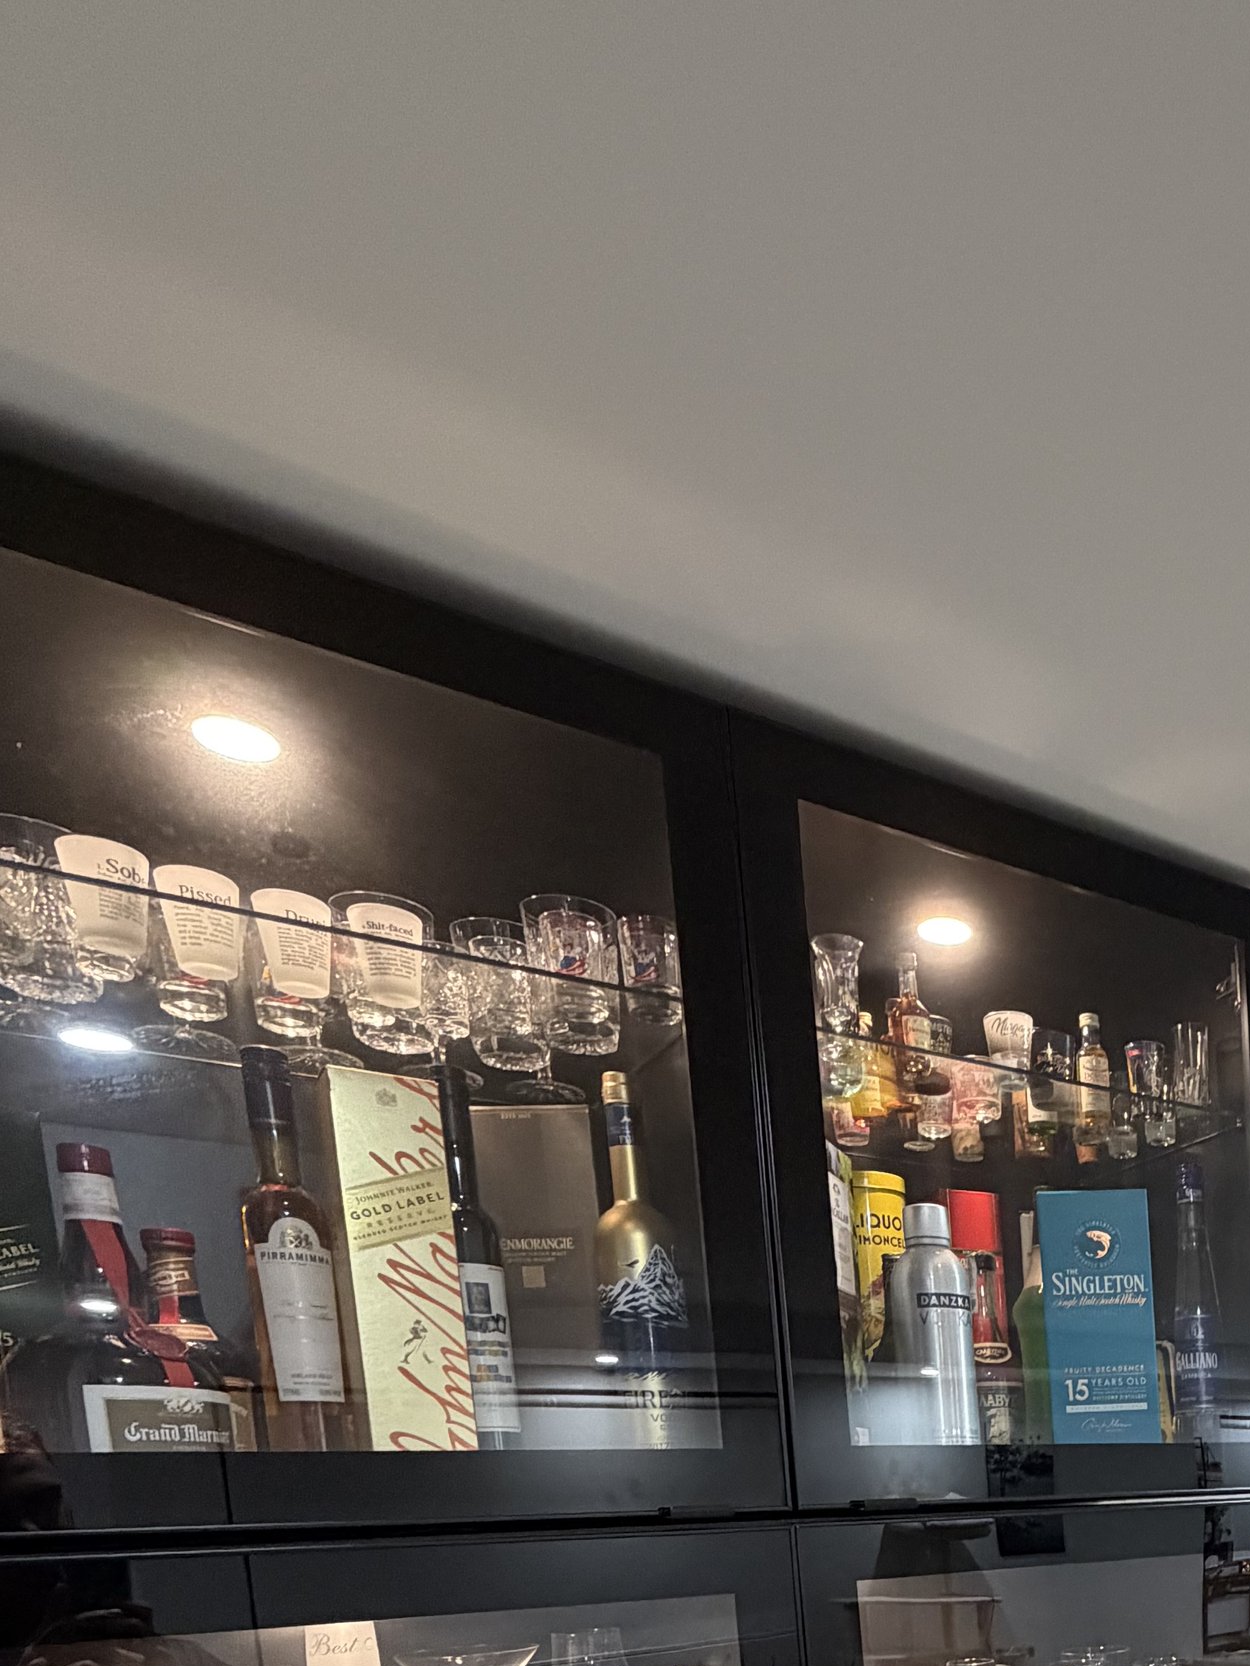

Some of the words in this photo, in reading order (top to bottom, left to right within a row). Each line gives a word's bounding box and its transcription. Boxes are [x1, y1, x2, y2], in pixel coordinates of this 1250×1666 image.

[366, 920, 413, 937] Shit-faced
[355, 1188, 395, 1205] JOHNNIE
[396, 1181, 434, 1194] WALKER
[350, 1203, 393, 1221] GOLD
[396, 1191, 445, 1210] LABEL
[366, 1208, 436, 1228] RESERVE
[260, 1250, 331, 1265] PIRRAMIMMA
[1066, 1268, 1079, 1276] THE
[920, 1295, 970, 1309] DANZKA
[1063, 1367, 1092, 1375] FRUITY
[1095, 1364, 1145, 1374] DECADENCE
[1175, 1351, 1218, 1371] GALLIANO
[1063, 1378, 1090, 1403] 15
[1090, 1378, 1124, 1387] YEARS
[1126, 1376, 1147, 1386] OLD
[124, 1421, 180, 1443] Grand
[309, 1632, 358, 1657] Best
